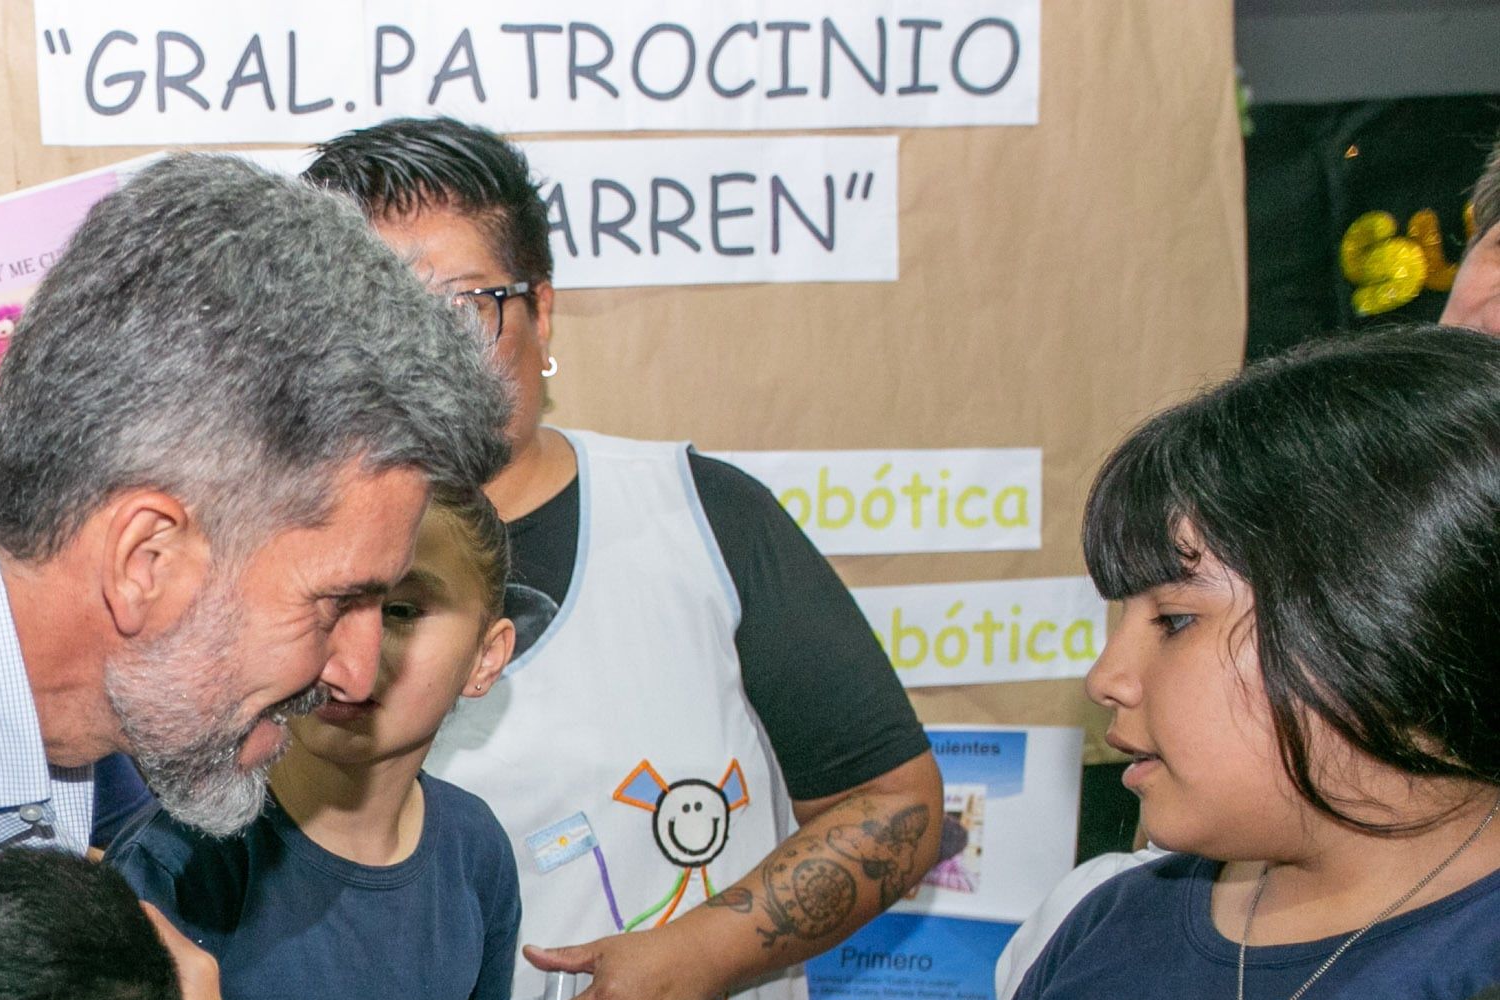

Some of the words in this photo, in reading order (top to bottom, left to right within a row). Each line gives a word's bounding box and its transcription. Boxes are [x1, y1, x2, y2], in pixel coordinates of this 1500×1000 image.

[550, 172, 874, 258] ARREN"
[8, 257, 36, 279] ME
[776, 464, 1029, 529] obótica
[872, 602, 1098, 671] bótica
[933, 740, 1001, 755] uientes
[840, 945, 933, 972] Primero
